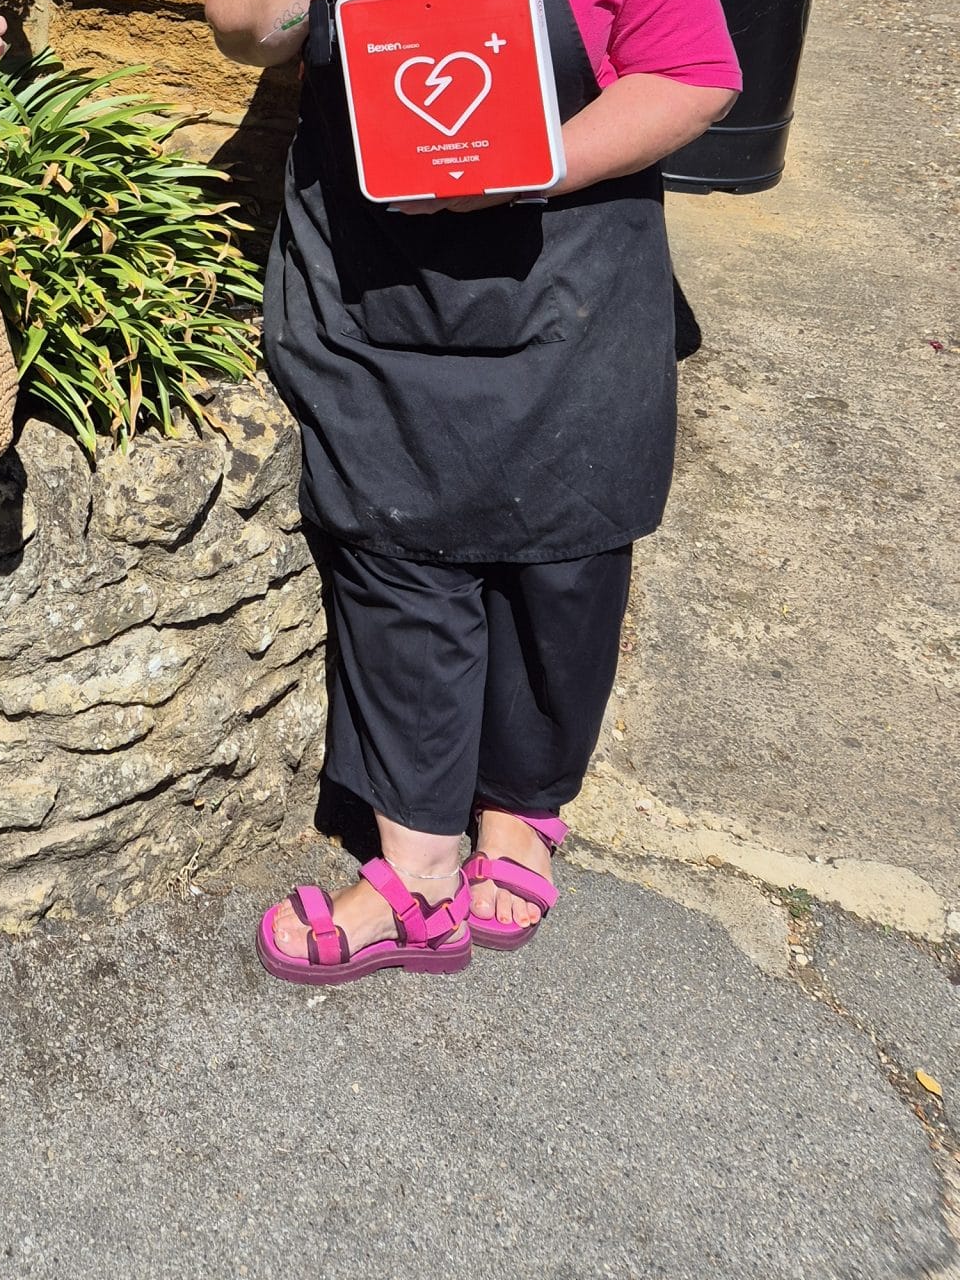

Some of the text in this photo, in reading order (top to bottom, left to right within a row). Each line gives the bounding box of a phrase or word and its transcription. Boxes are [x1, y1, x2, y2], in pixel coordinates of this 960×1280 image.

[367, 42, 402, 54] Bexen
[416, 140, 489, 153] REANIBEX 100
[432, 155, 480, 165] DEFIBRILLATOR
